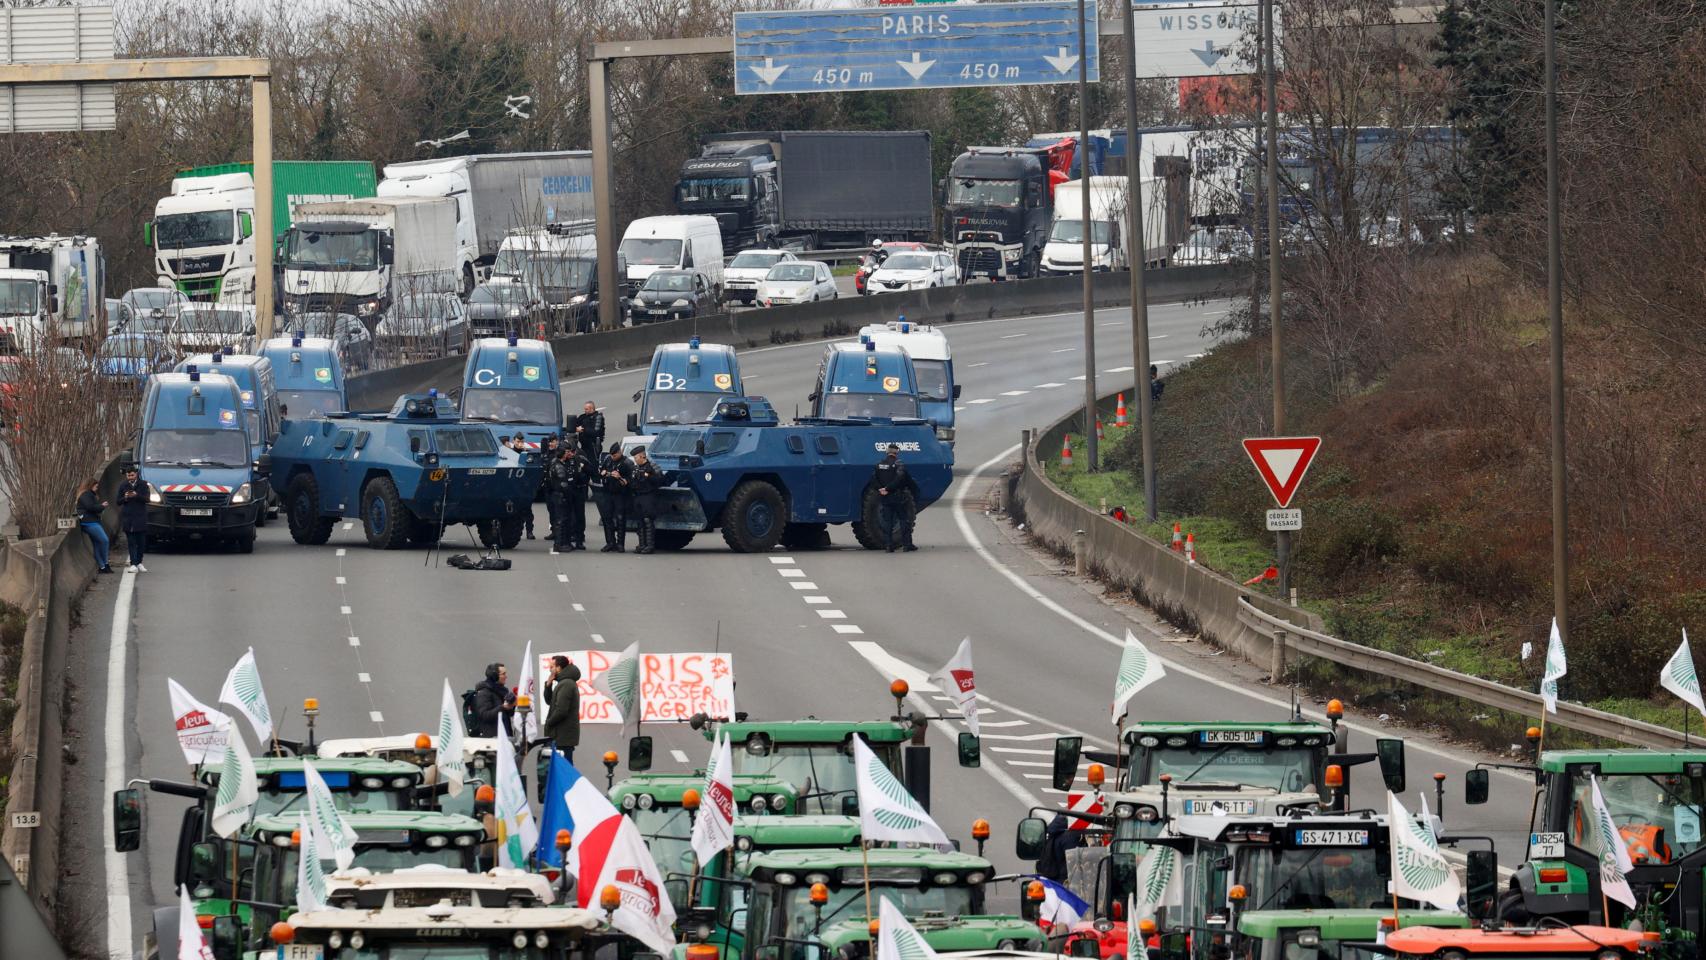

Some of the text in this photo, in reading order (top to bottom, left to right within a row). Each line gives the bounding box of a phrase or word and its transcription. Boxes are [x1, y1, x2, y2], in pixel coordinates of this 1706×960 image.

[882, 15, 950, 34] PARIS
[813, 69, 874, 84] 450 m
[960, 63, 1020, 79] 450 m
[543, 176, 592, 195] GEORGELIN
[475, 369, 502, 386] C1
[656, 373, 687, 390] B2
[302, 435, 314, 447] 10
[875, 442, 920, 451] GENRMERIE
[508, 468, 525, 479] 10
[642, 680, 717, 701] PASSER
[1194, 801, 1245, 813] DV-6-TT
[16, 815, 37, 824] 13.8
[1302, 831, 1361, 844] GS-471-XC
[1543, 845, 1554, 856] 77
[415, 928, 462, 937] CLAAS
